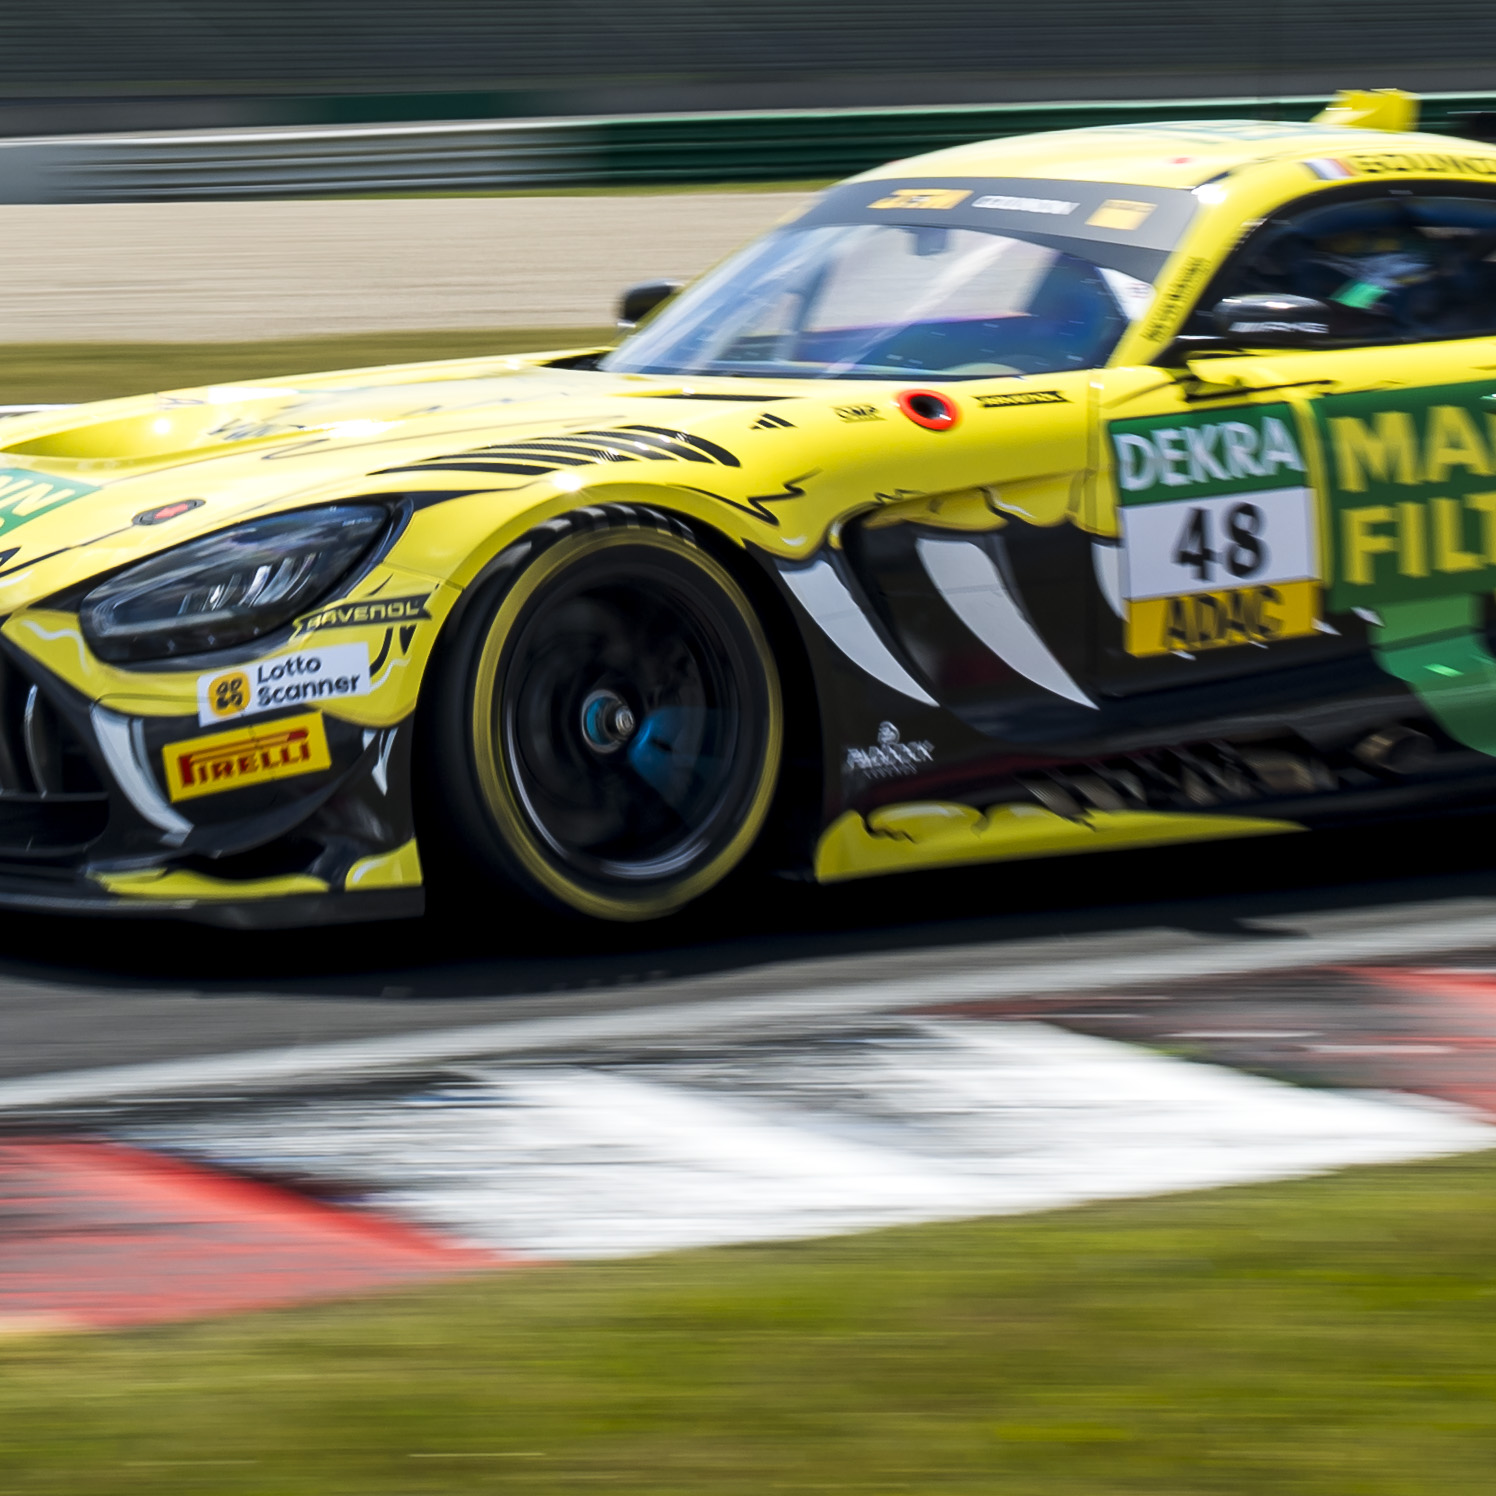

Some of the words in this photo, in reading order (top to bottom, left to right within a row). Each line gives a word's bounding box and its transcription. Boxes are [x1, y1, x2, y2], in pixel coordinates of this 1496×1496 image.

[1113, 416, 1308, 491] DEKRA
[1173, 502, 1271, 583] 48
[305, 600, 420, 630] RAVENOL
[1162, 585, 1284, 652] ADAC
[256, 655, 321, 684] Lotto
[256, 674, 360, 707] Scanner
[177, 726, 310, 789] PIRELLI
